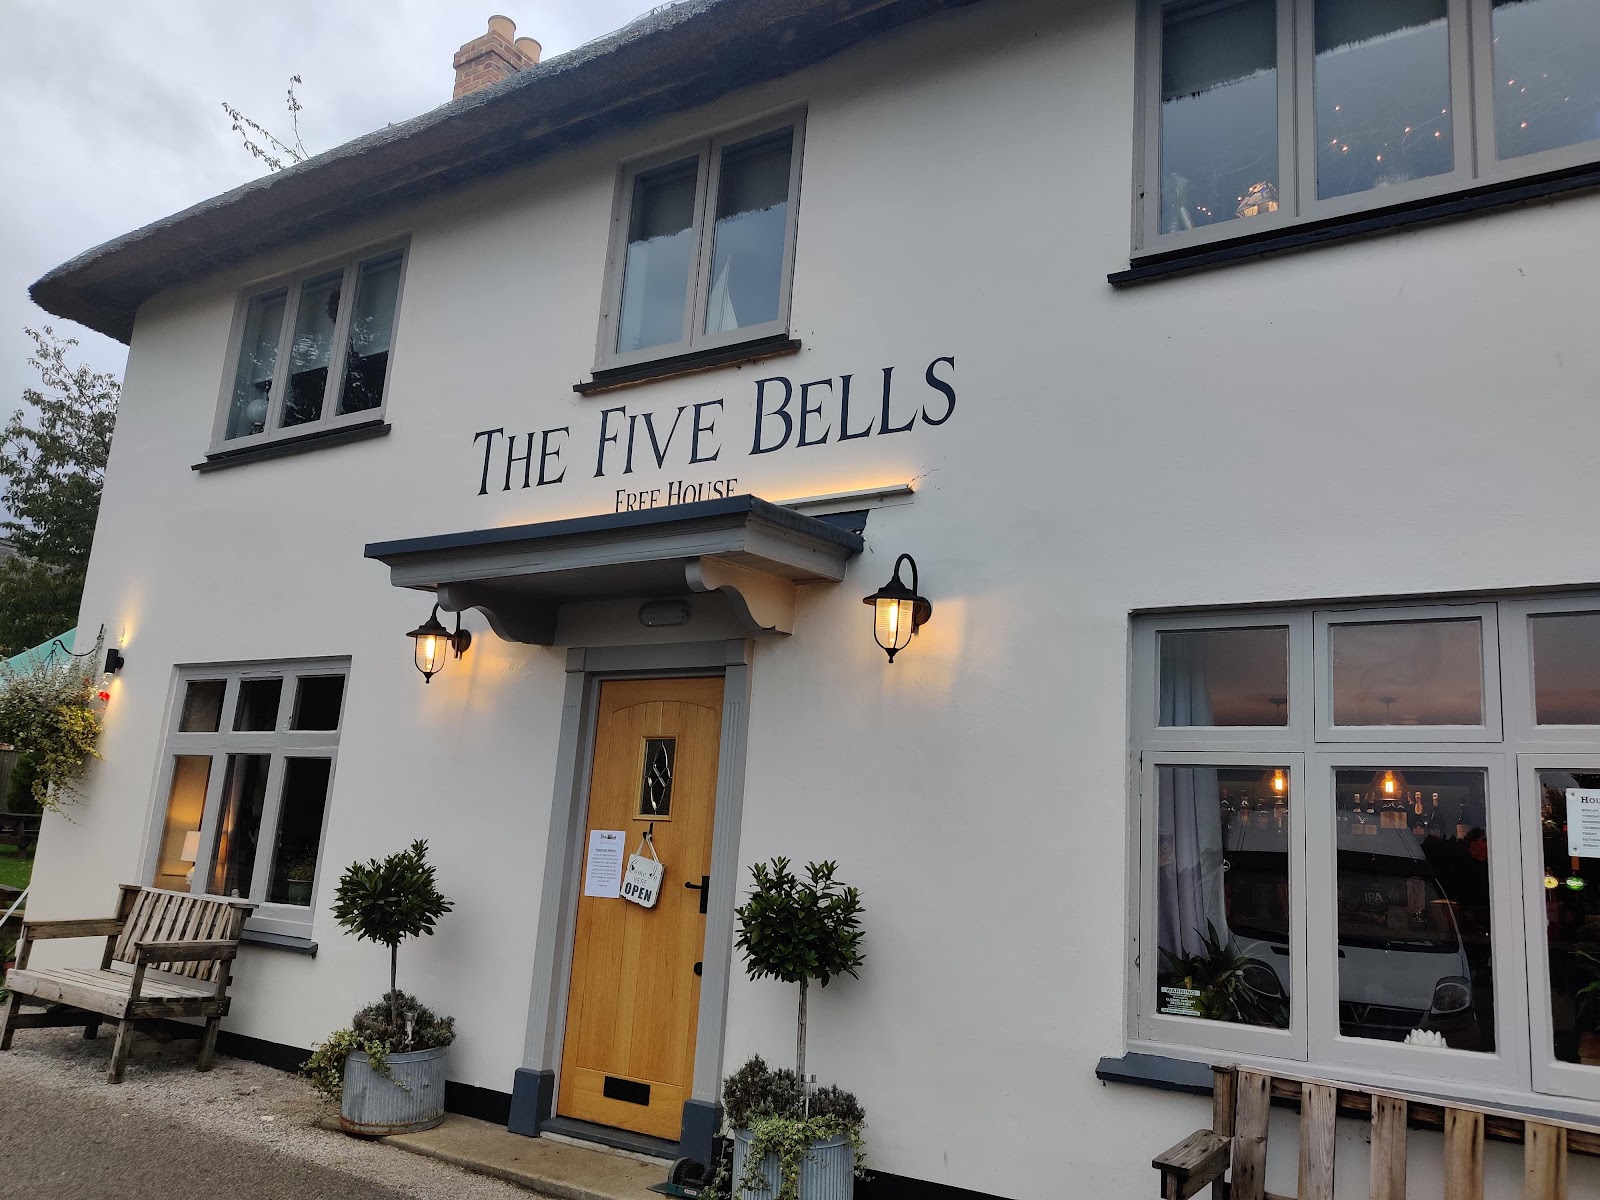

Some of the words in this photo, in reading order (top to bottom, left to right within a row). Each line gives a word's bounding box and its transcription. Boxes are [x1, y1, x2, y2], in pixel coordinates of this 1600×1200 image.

[472, 426, 570, 497] THE
[592, 398, 725, 479] FIVE
[748, 355, 957, 457] BELLS
[615, 488, 661, 513] FREE
[666, 478, 738, 506] HOUSE
[624, 882, 652, 902] OPEN
